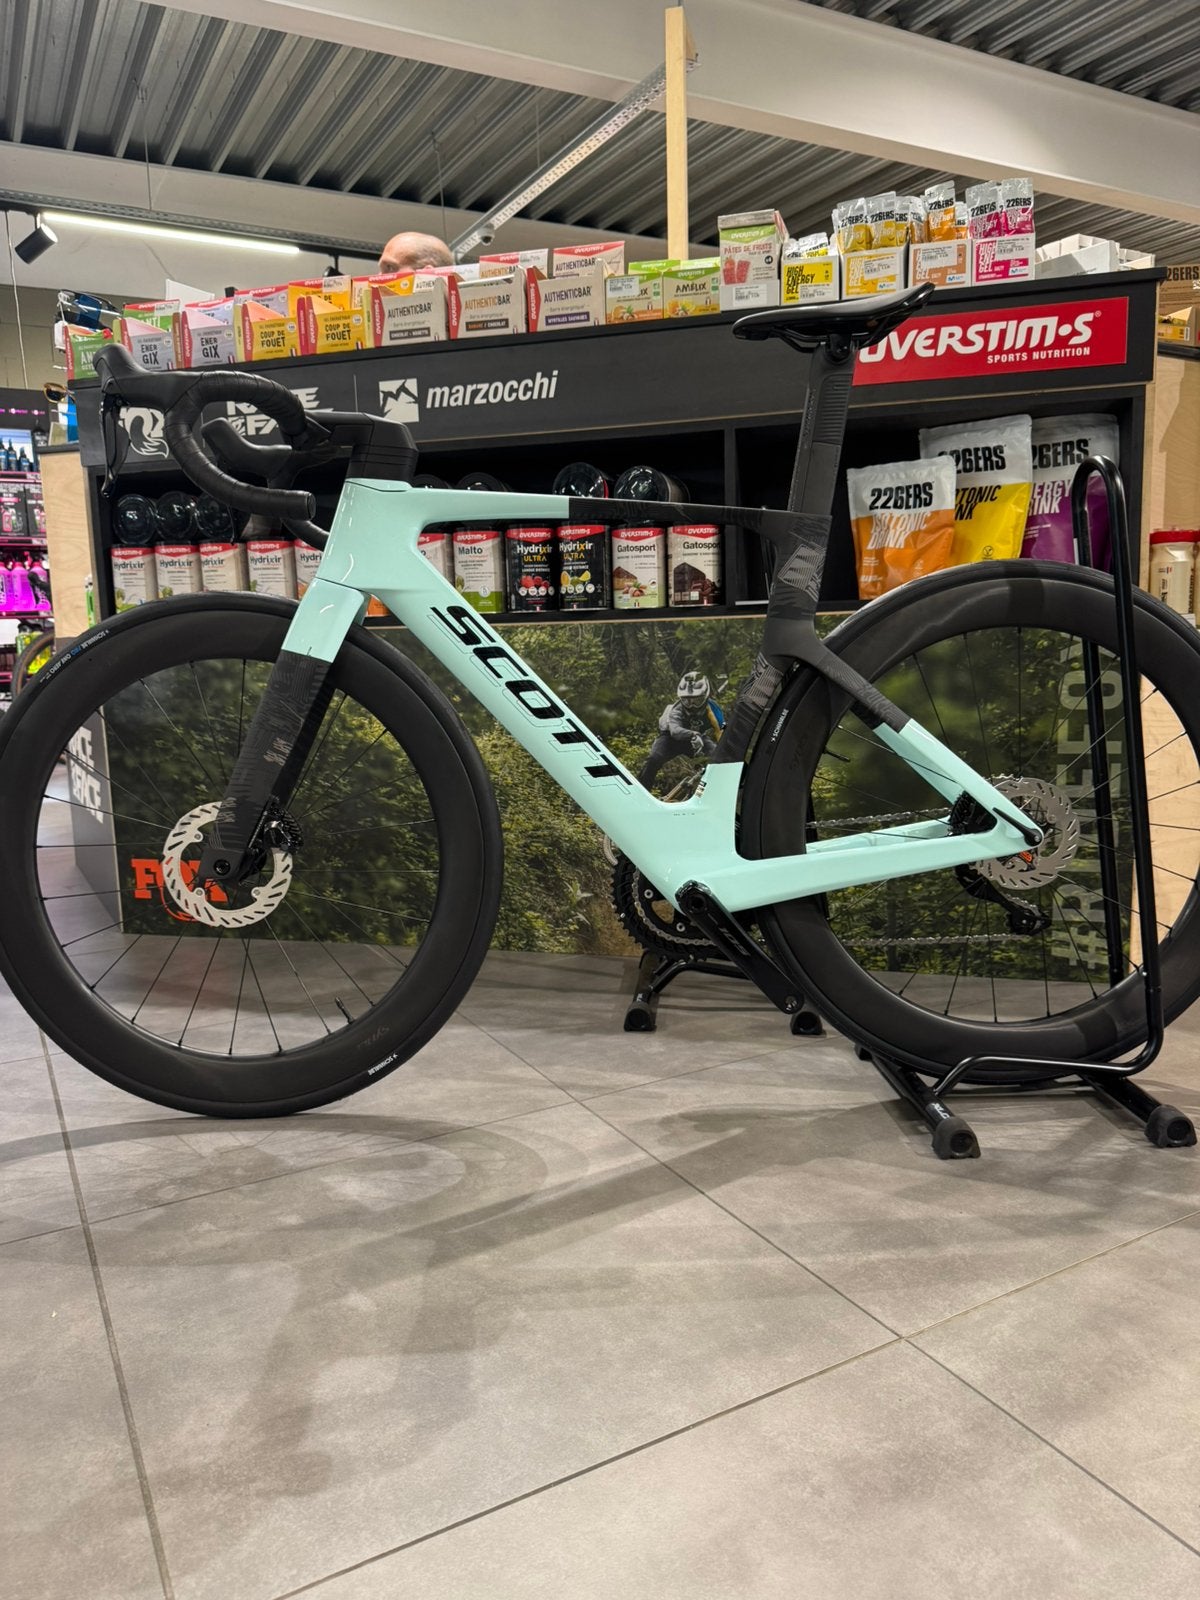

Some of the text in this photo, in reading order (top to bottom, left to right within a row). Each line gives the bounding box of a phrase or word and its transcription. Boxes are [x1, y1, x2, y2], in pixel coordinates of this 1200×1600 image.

[929, 198, 954, 210] 226ERS
[1006, 198, 1031, 208] 226ERS
[870, 211, 895, 223] 226ERS
[752, 243, 772, 252] FRUITS
[786, 266, 804, 276] HIGH
[979, 262, 993, 273] GEL
[1167, 266, 1200, 281] 26ERS
[786, 274, 815, 287] ENERGY
[544, 286, 591, 303] AUTHENTICBAR
[786, 284, 799, 294] GEL
[465, 295, 511, 310] AUTHENTICBAR
[388, 303, 432, 318] AUTHENTICBAR
[326, 330, 351, 340] FOUET
[201, 337, 218, 346] ENER
[261, 337, 286, 348] FOUET
[141, 344, 157, 353] ENER
[202, 345, 220, 358] GIX
[142, 352, 159, 365] GIX
[987, 346, 1090, 364] SPORTS NUTRITION
[426, 370, 558, 409] marzocchi
[938, 445, 1006, 474] 26ERS
[1033, 439, 1090, 469] 26ERS
[955, 485, 1001, 504] TONIC
[1033, 480, 1071, 498] ERGY
[869, 482, 933, 510] 226ERS
[1028, 496, 1062, 515] RINK
[871, 512, 932, 531] ISOTONIC
[559, 541, 593, 551] Hydrixir
[683, 541, 721, 550] Gatospor
[867, 530, 909, 550] DRINK
[458, 547, 483, 555] Malto
[517, 544, 553, 554] Hydrixir
[617, 544, 656, 554] Gatosport
[160, 559, 193, 569] Hydrixir
[202, 558, 224, 568] drixir
[250, 555, 281, 565] Hydrixir
[300, 553, 322, 563] Hydri
[113, 560, 145, 570] Hydrixir
[430, 605, 633, 786] SCOTT
